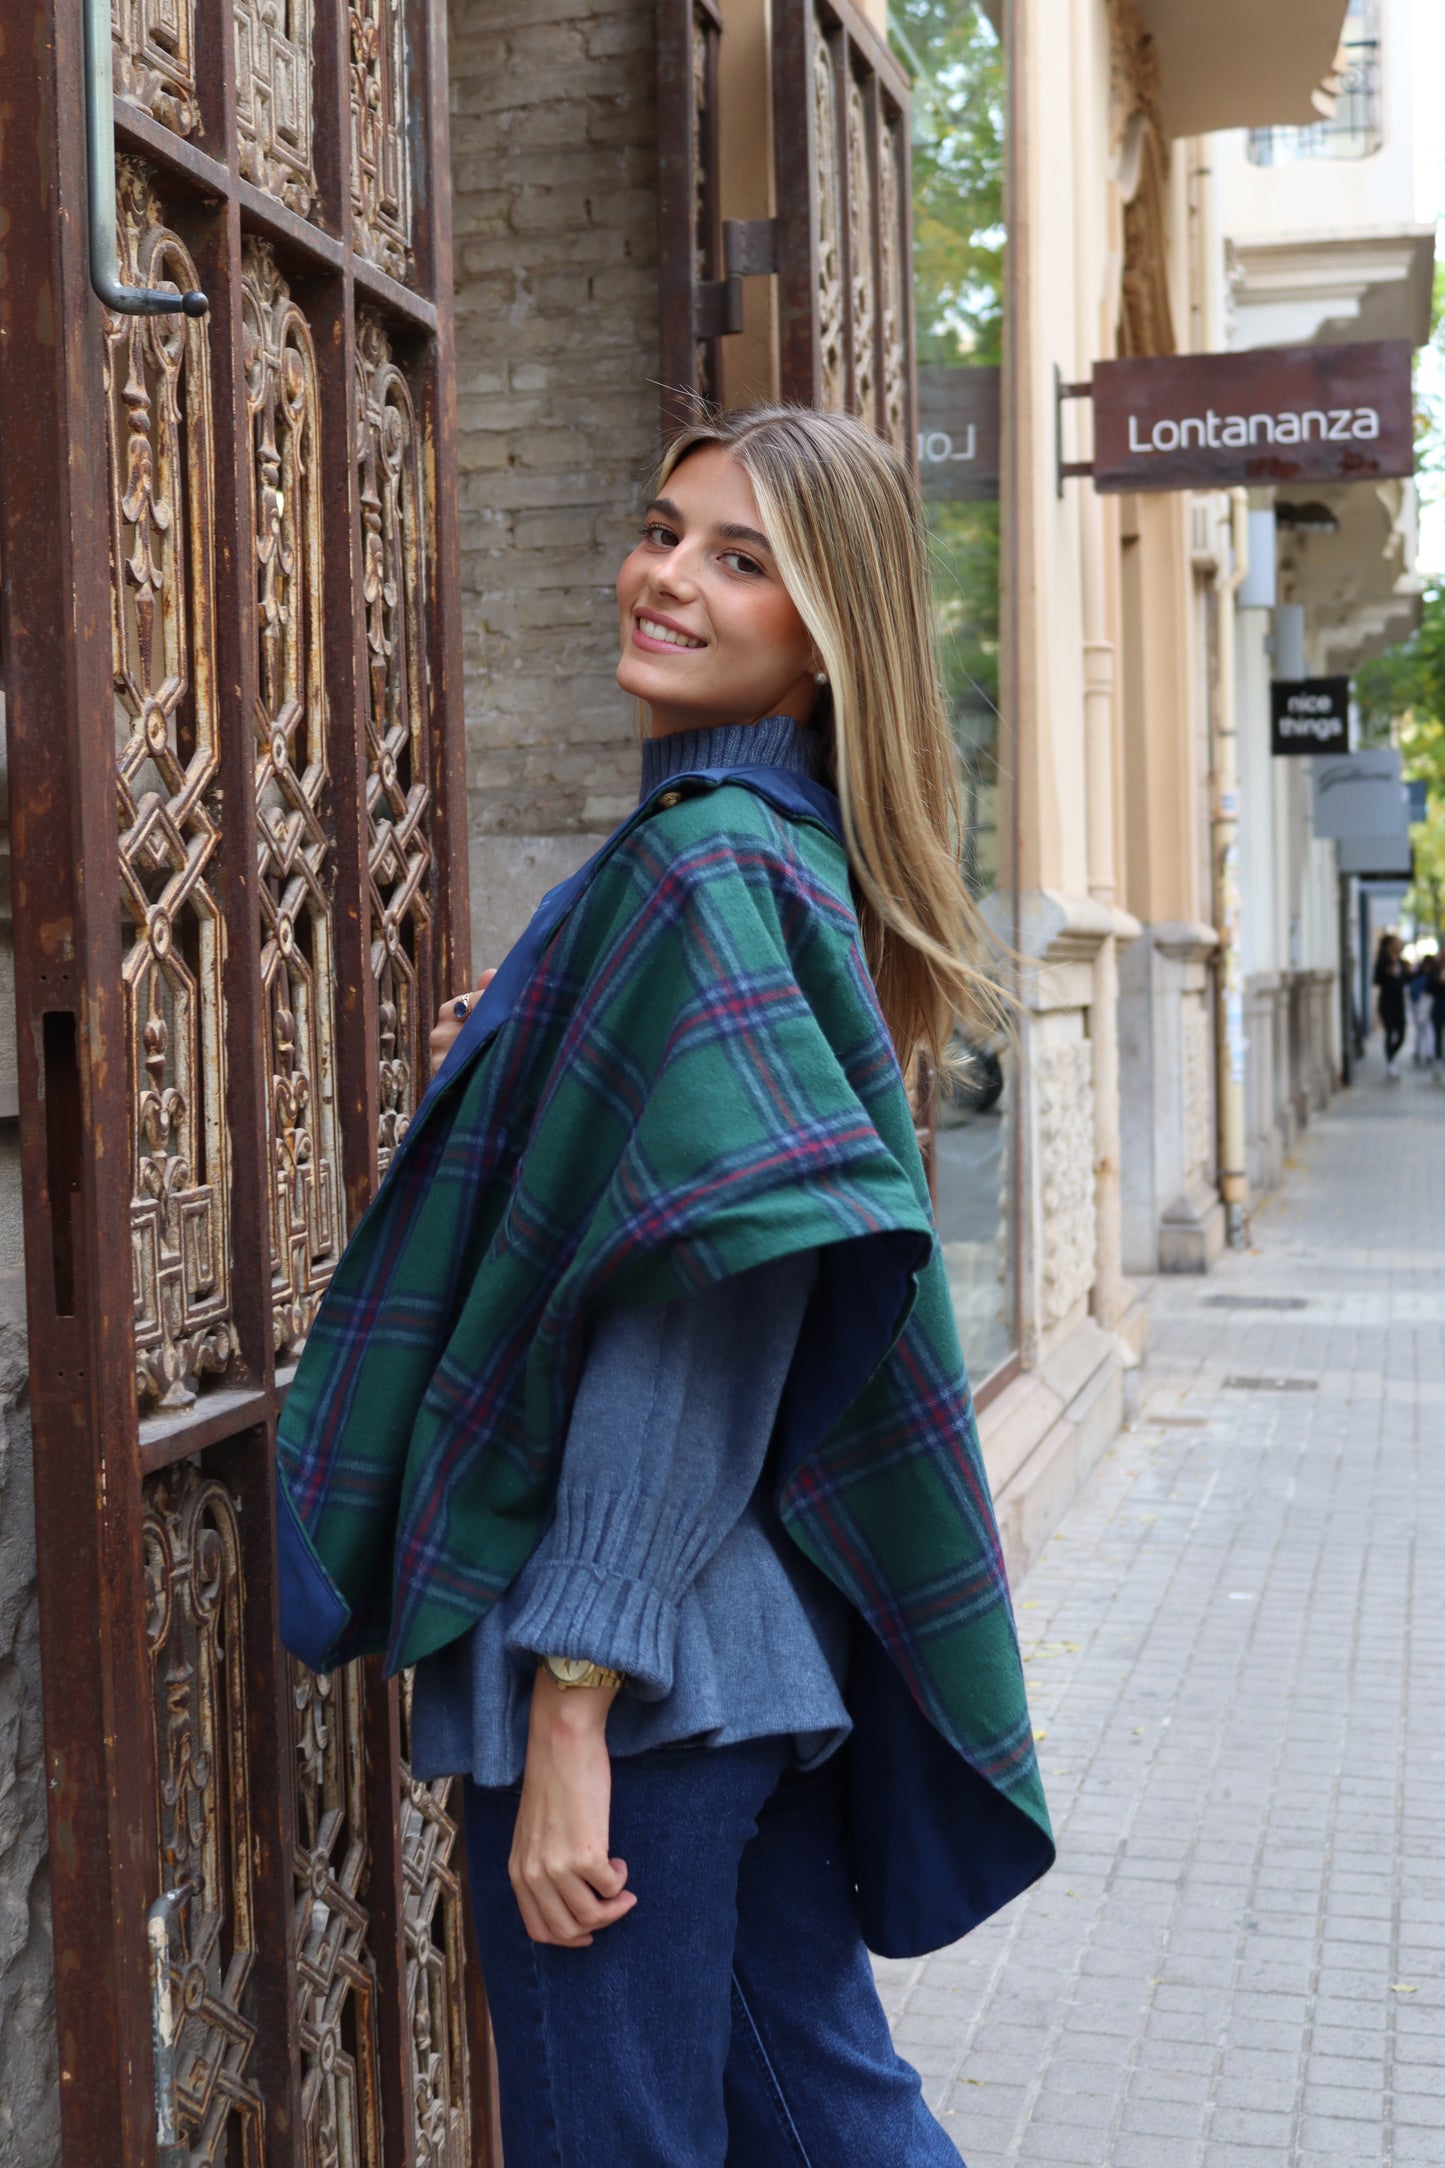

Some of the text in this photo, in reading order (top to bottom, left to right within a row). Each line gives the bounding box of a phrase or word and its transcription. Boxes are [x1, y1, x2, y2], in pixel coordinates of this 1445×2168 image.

[1128, 407, 1380, 452] Lontananza
[1287, 692, 1332, 713] nice
[1279, 715, 1342, 740] things
